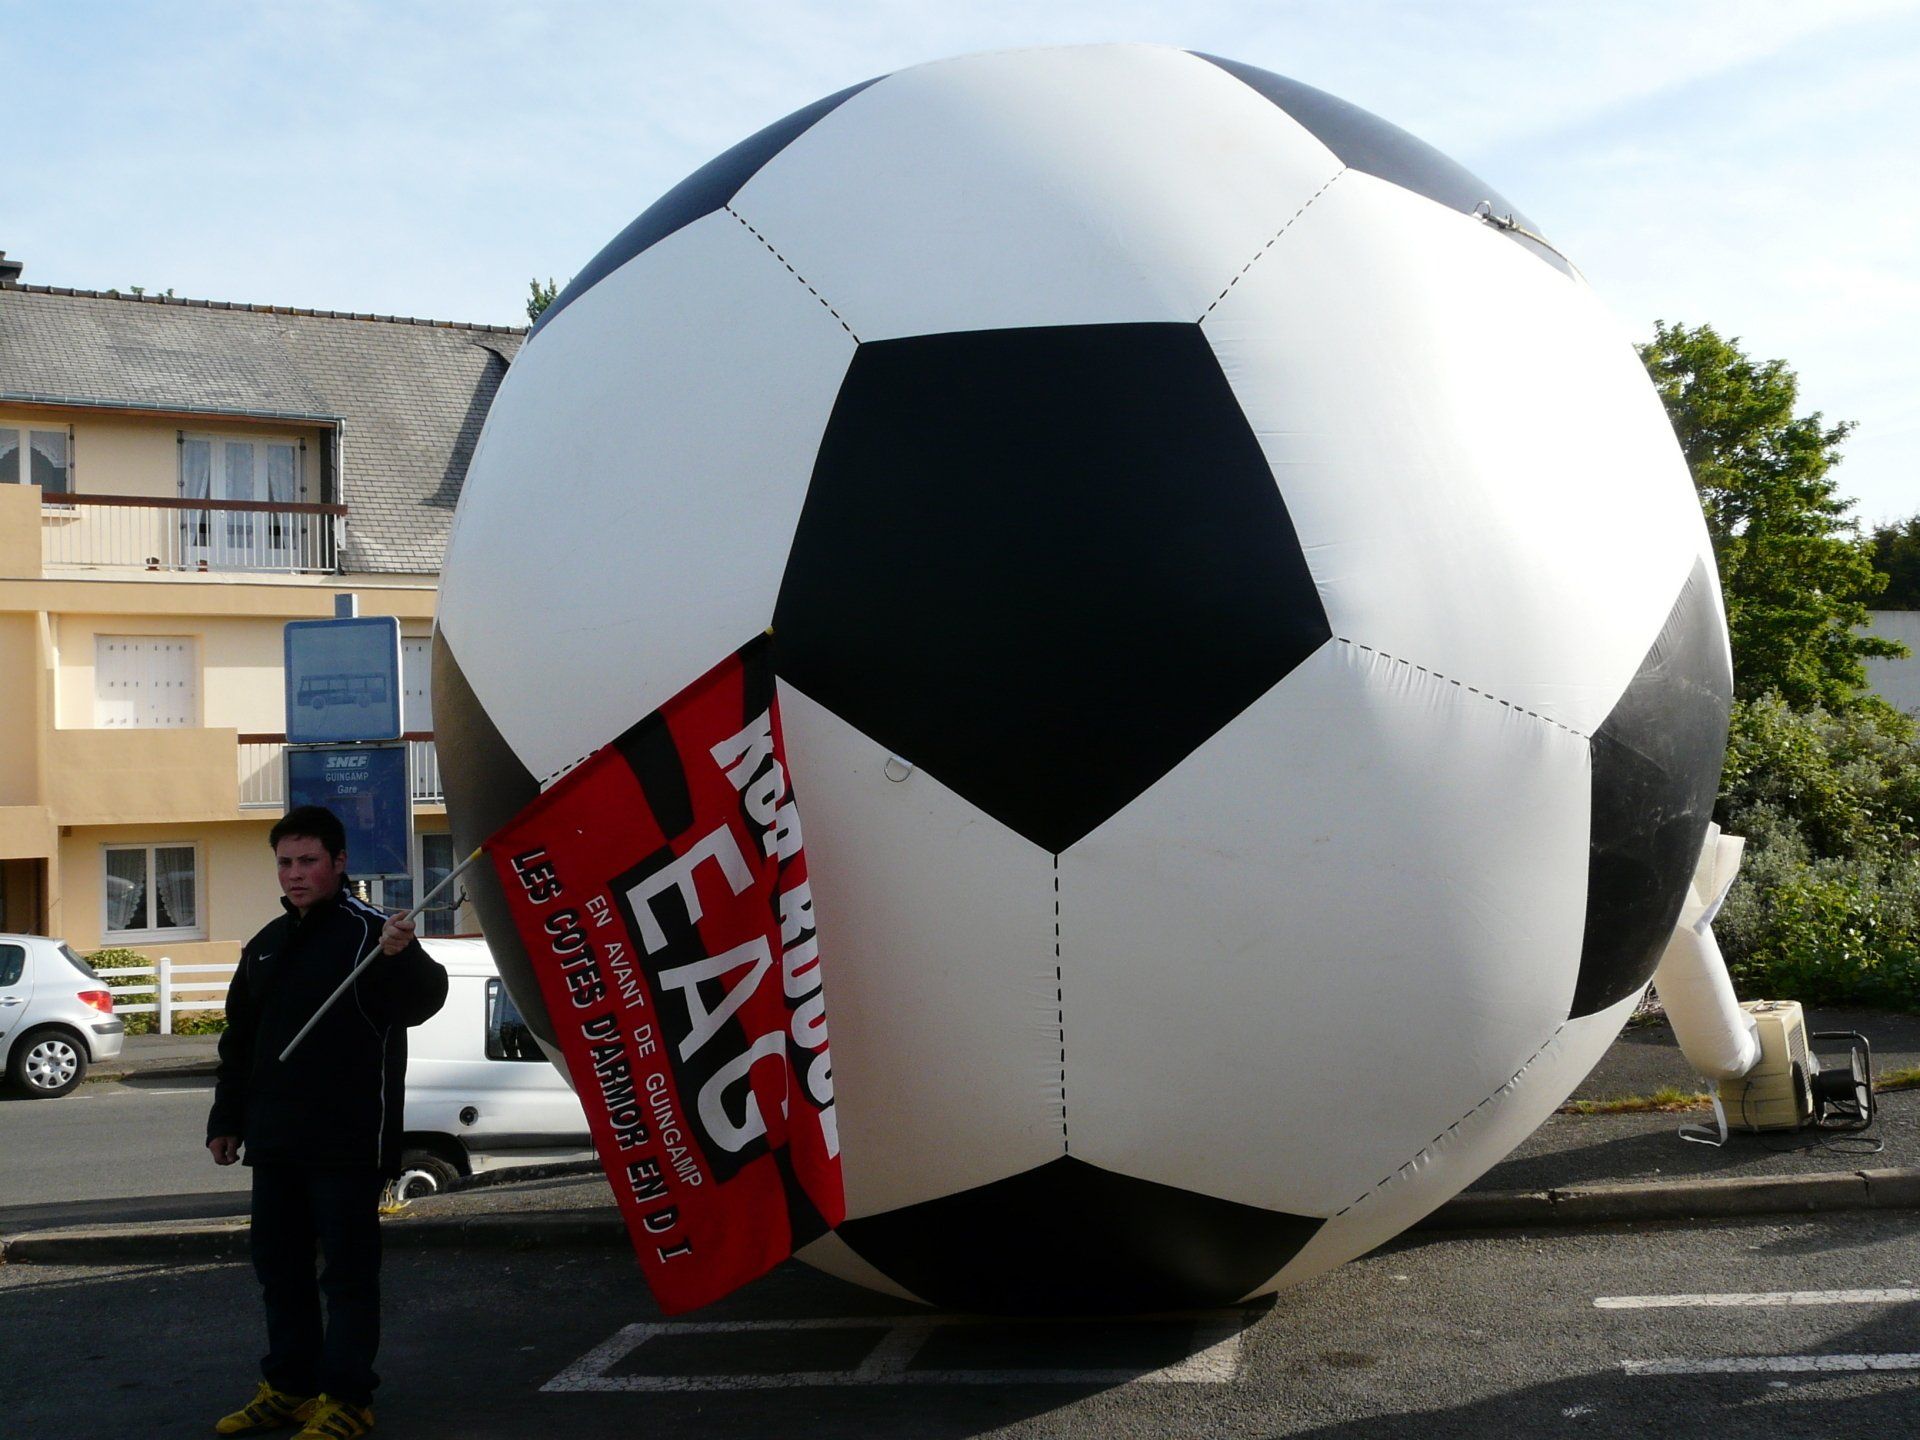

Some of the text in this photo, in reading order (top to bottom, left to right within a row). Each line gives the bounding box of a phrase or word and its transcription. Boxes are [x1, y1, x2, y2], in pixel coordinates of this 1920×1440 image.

[325, 772, 369, 782] GUINGAMP
[326, 756, 368, 767] SNCF
[337, 785, 358, 794] Gare
[510, 845, 563, 905] LES
[544, 908, 605, 1008] COTES
[581, 1012, 650, 1151] D'ARMOR
[626, 1157, 669, 1204] EN
[585, 894, 703, 1188] EN AVANT DE GUINGAMP
[625, 823, 788, 1153] EAG
